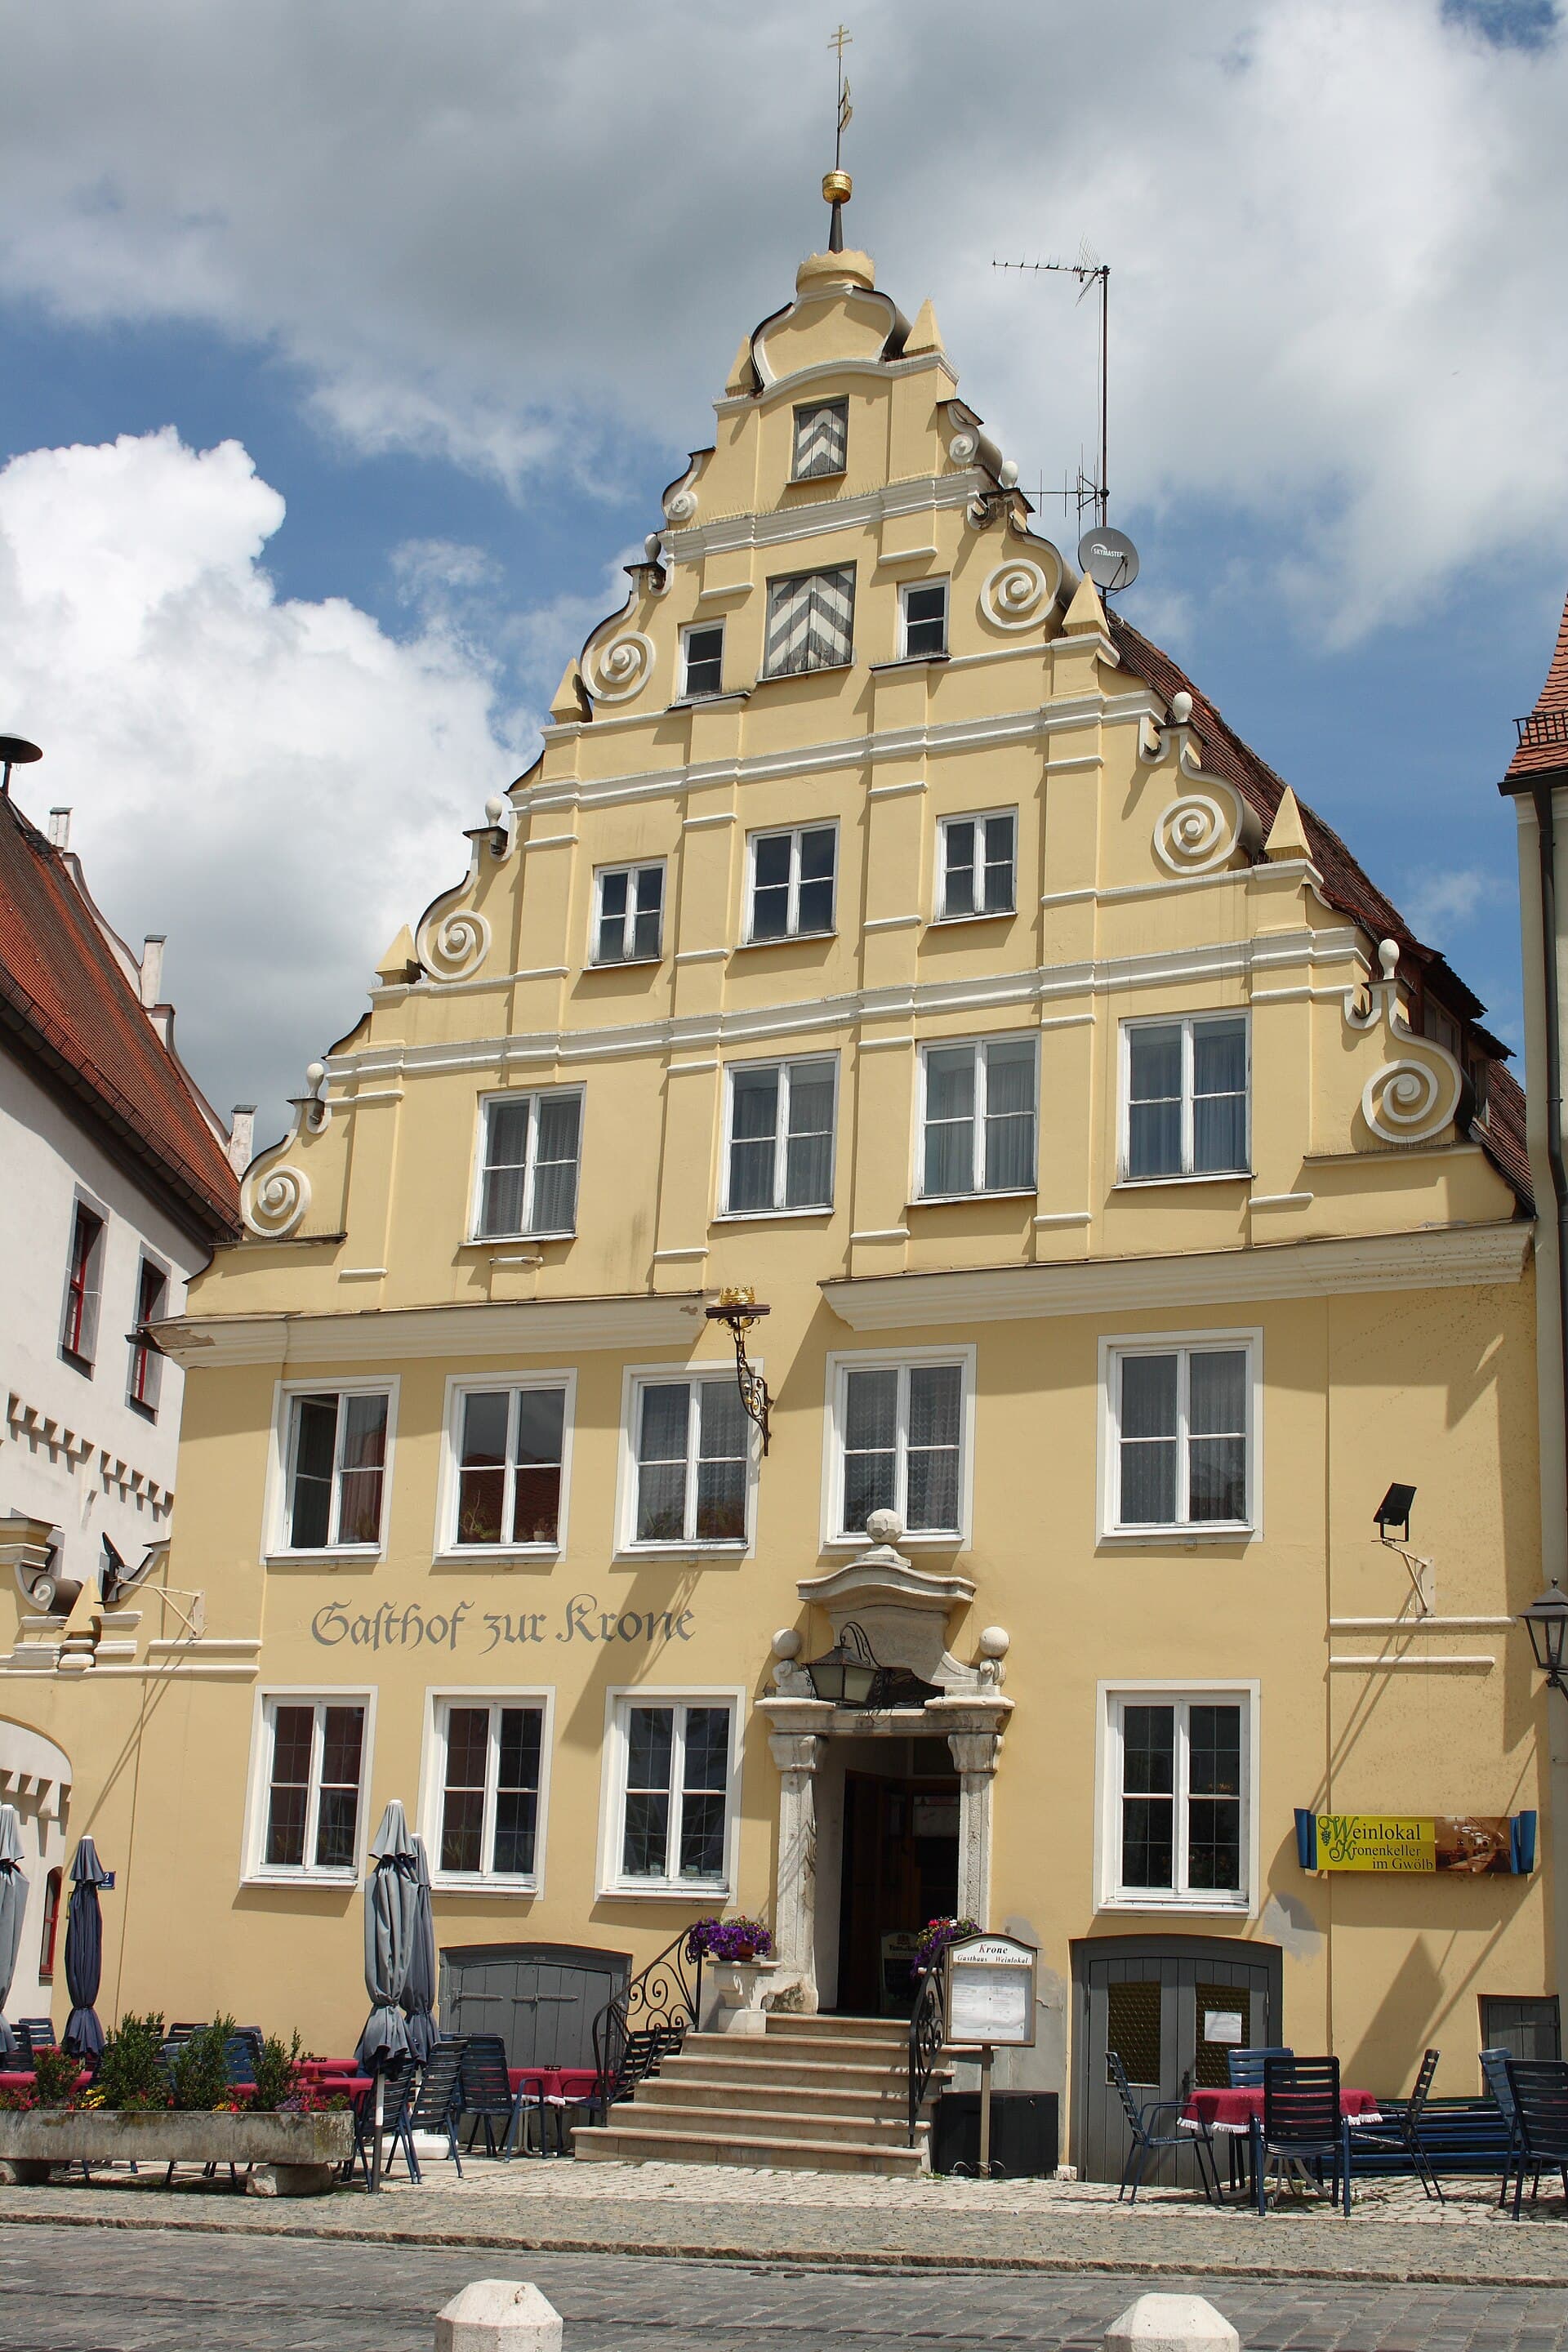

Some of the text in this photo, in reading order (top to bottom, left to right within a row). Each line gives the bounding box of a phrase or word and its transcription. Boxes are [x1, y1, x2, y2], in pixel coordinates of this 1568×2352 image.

[479, 1610, 548, 1655] zur
[556, 1593, 697, 1644] Krone
[1324, 1815, 1421, 1842] Weinlokal
[1329, 1838, 1421, 1862] Kronenkeller
[1373, 1857, 1433, 1870] im Gwölb
[978, 1944, 1009, 1954] Krone
[957, 1954, 1028, 1964] Gasthaus Weinlokal
